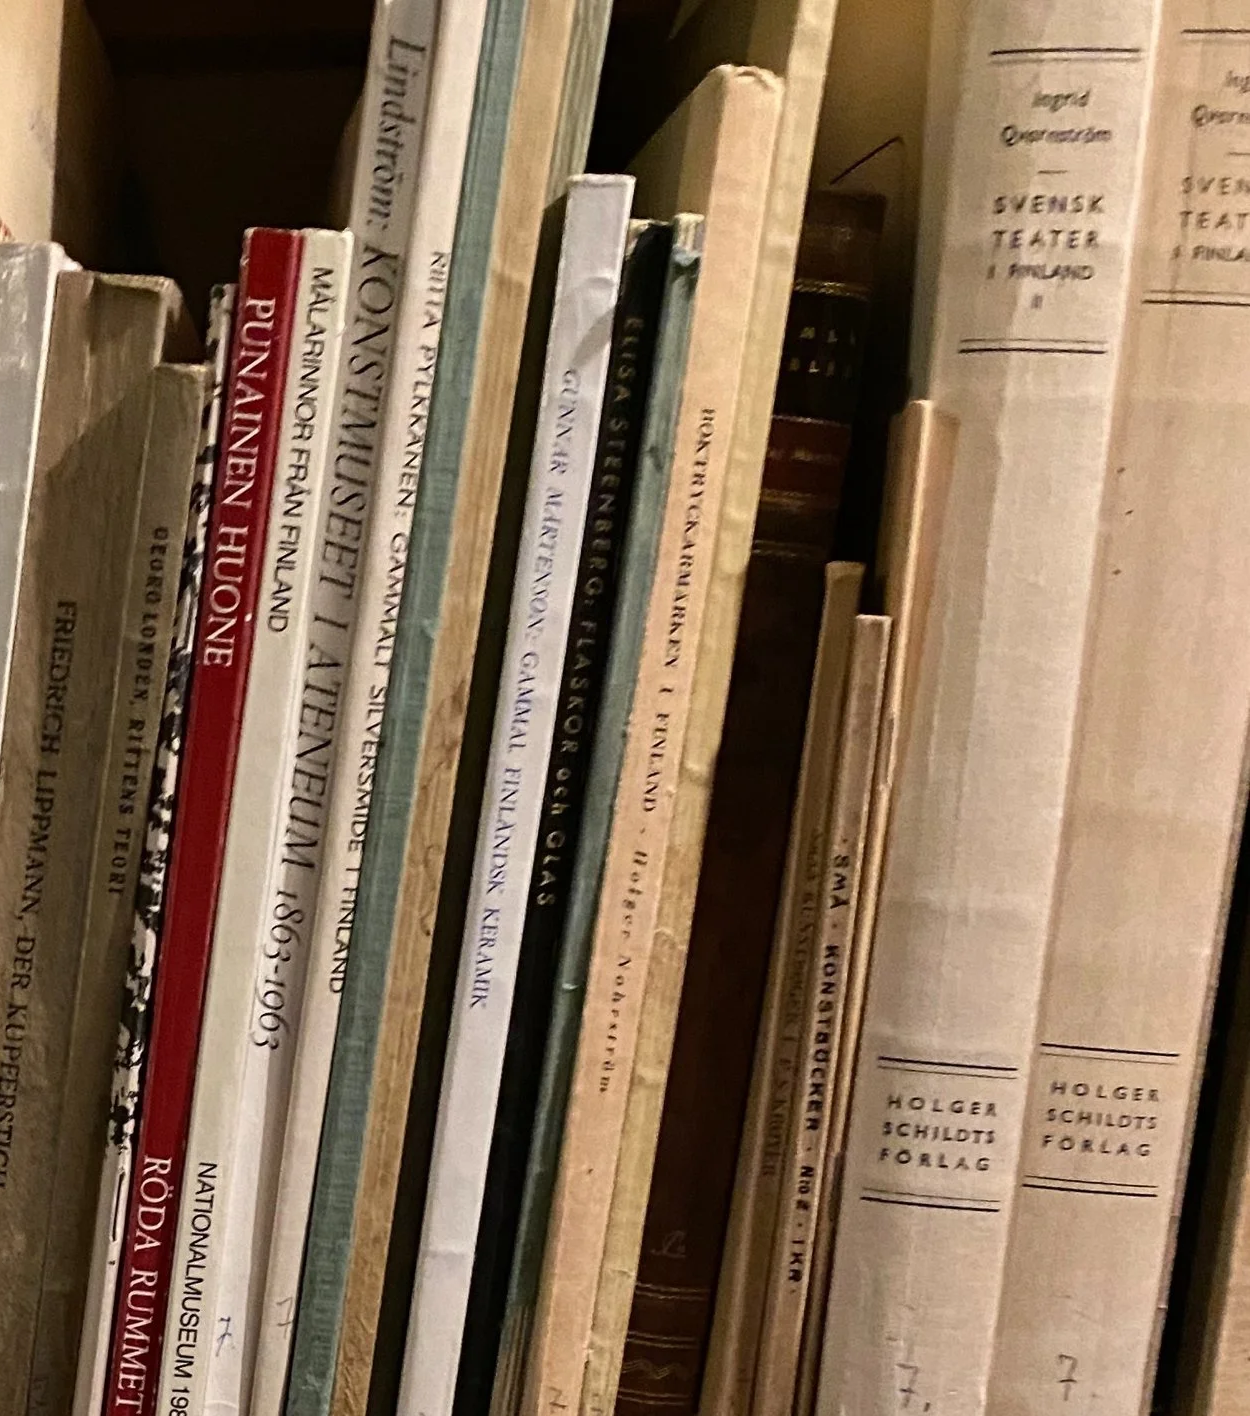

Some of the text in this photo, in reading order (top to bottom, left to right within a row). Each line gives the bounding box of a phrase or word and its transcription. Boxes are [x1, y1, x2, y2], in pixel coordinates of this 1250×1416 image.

[991, 228, 1101, 250] TEATER
[992, 194, 1105, 216] SVENSK
[1006, 263, 1095, 281] FINLAND
[267, 267, 334, 633] MÅLARINNOR FRÅN FINLAND
[319, 242, 402, 600] KONSTMUSEET
[203, 298, 276, 669] PUNAINEN HUONE
[373, 532, 412, 667] GAMMALT
[39, 600, 78, 756] FRIEDRICH
[468, 369, 582, 1009] GUNNAR GAMMAL KERAMIK
[562, 619, 601, 753] FLASKOR
[281, 644, 343, 870] ATENEUM
[643, 713, 671, 814] FINLAND
[534, 834, 566, 908] GLAS
[11, 935, 36, 991] DER
[882, 1120, 996, 1146] SCHILDTS
[886, 1094, 998, 1118] HOLGER
[1046, 1106, 1159, 1131] SCHILDTS
[1049, 1079, 1161, 1103] HOLGER
[115, 1154, 173, 1414] RÖDA RUMMET
[174, 1161, 219, 1379] NATIONALMUSEUM
